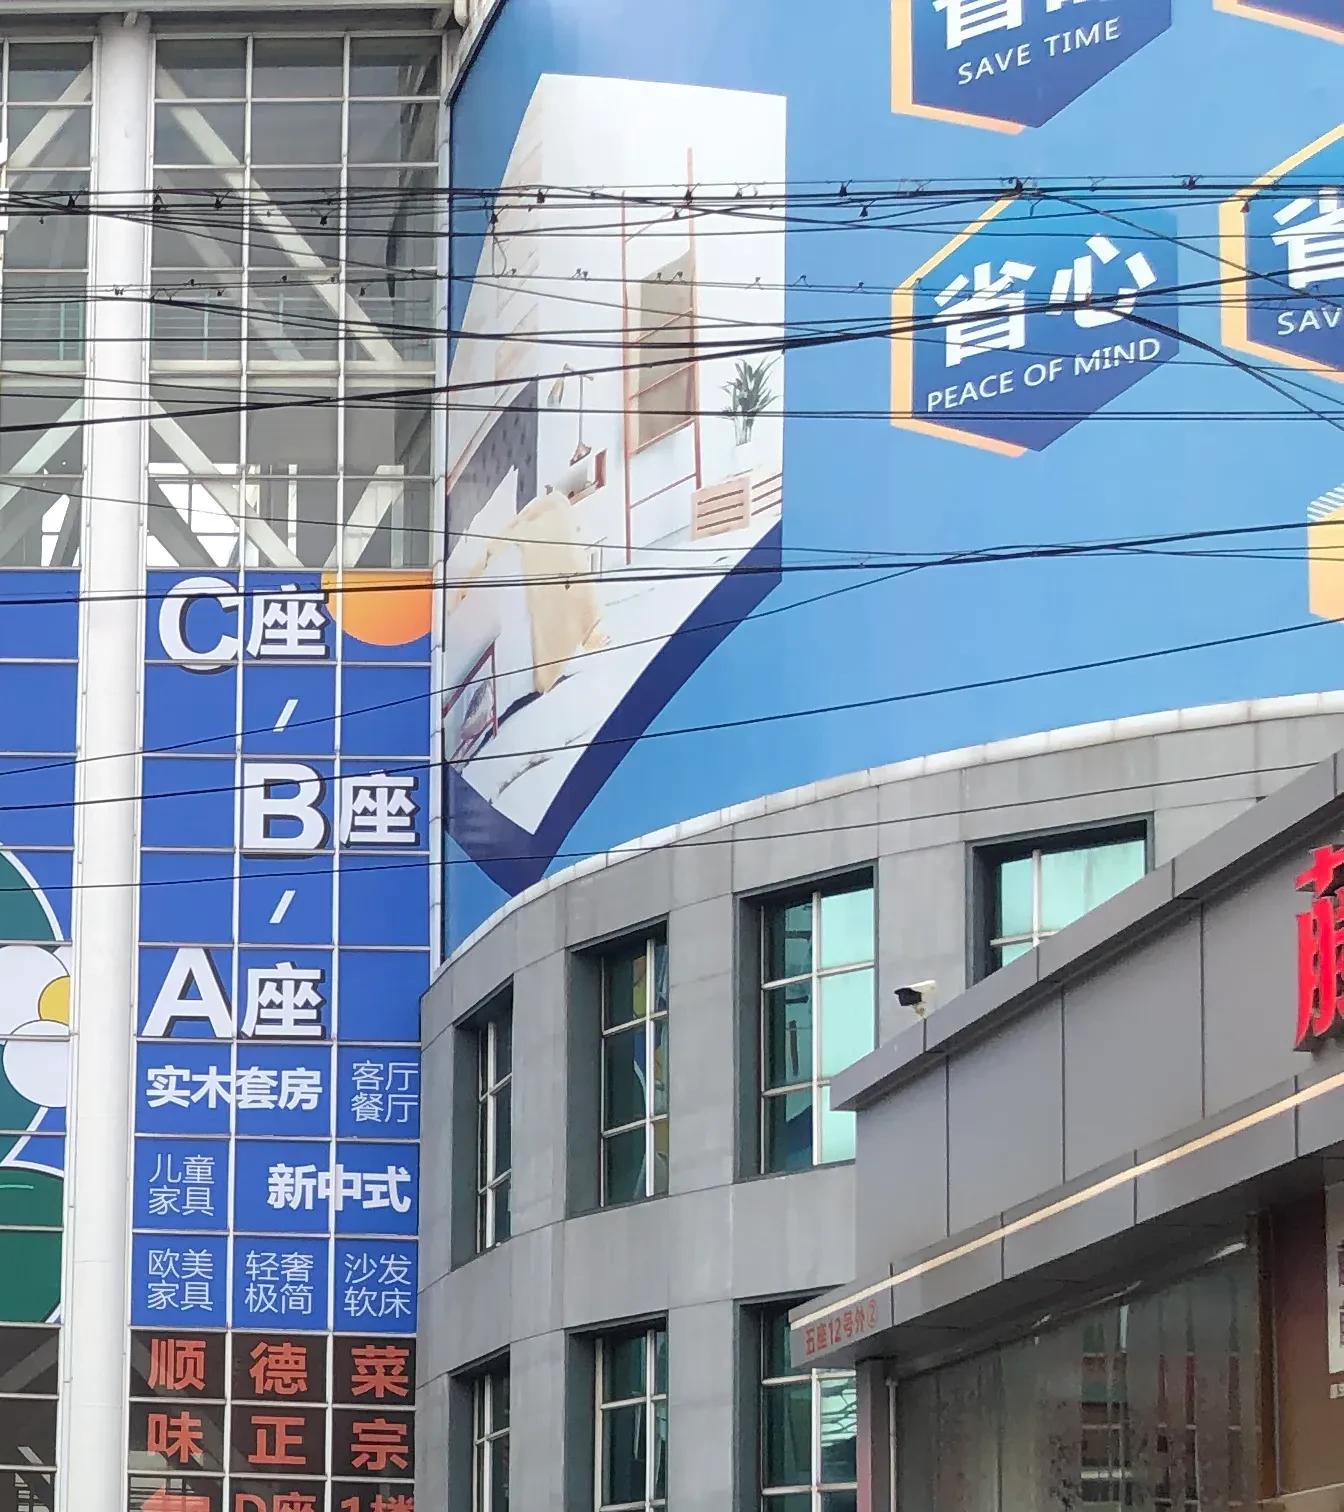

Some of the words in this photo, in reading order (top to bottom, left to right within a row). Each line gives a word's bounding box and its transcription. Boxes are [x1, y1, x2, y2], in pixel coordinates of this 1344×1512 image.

[957, 43, 1031, 85] SAVE
[1043, 18, 1121, 58] TIME
[933, 233, 1158, 368] 省心
[927, 370, 1014, 413] PEACE
[1024, 356, 1063, 388] OF
[1074, 336, 1162, 373] MIND
[159, 577, 329, 673] C座
[243, 762, 419, 851] B座
[142, 946, 322, 1038] A座
[145, 1065, 323, 1110] 实木套房
[351, 1060, 419, 1092] 客厅
[350, 1094, 419, 1123] 餐厅
[149, 1153, 216, 1185] 儿童
[267, 1163, 412, 1212] 新中式
[148, 1185, 215, 1217] 家具
[148, 1248, 214, 1281] 欧美
[245, 1249, 314, 1282] 轻奢
[344, 1252, 412, 1286] 沙发
[147, 1280, 214, 1311] 家具
[244, 1282, 313, 1315] 极简
[343, 1285, 412, 1319] 软床
[147, 1338, 409, 1398] 顺德菜
[147, 1411, 409, 1471] 味正宗
